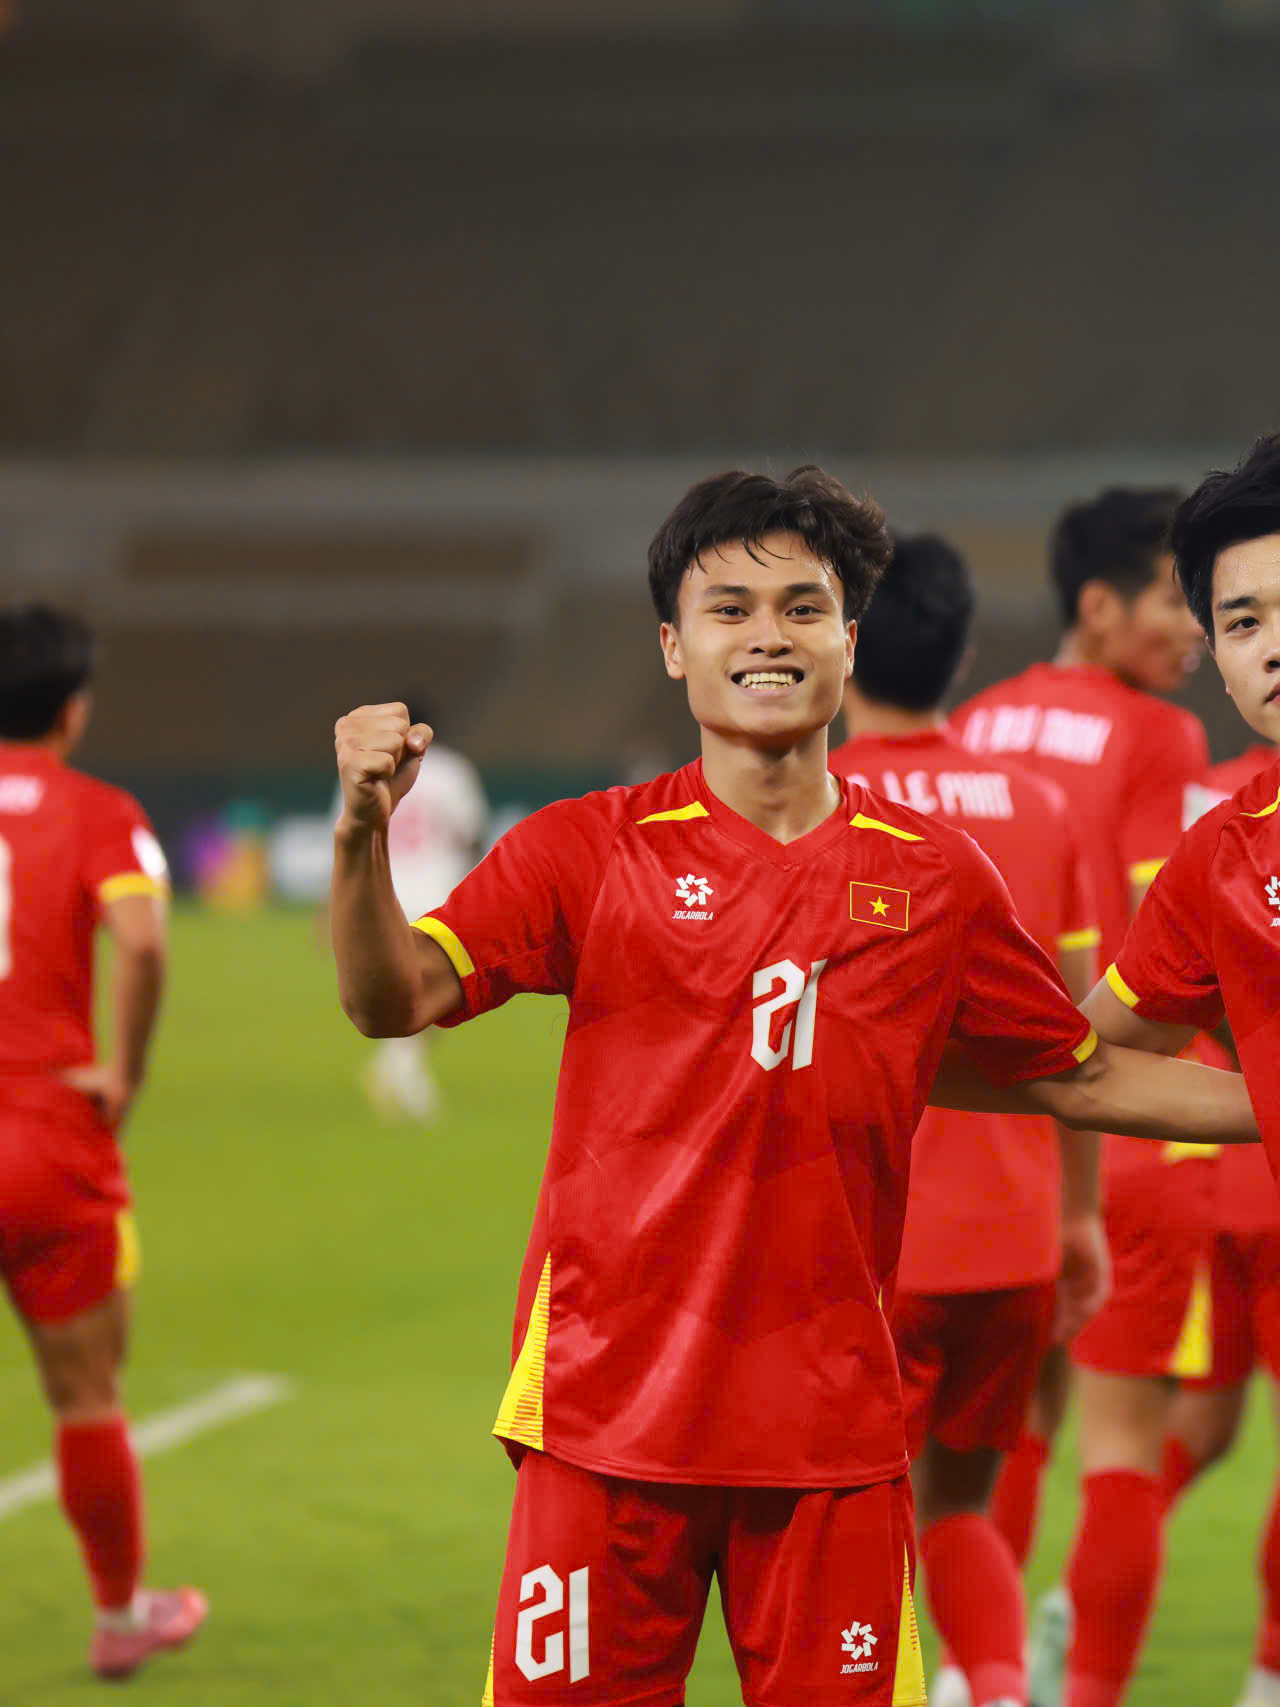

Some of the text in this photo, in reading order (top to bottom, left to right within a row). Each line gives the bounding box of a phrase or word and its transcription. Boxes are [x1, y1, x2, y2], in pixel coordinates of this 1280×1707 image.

[672, 910, 714, 921] JOGARBOLA
[751, 959, 828, 1071] 21
[515, 1564, 590, 1684] 21
[840, 1661, 879, 1674] JOGARBOLA
